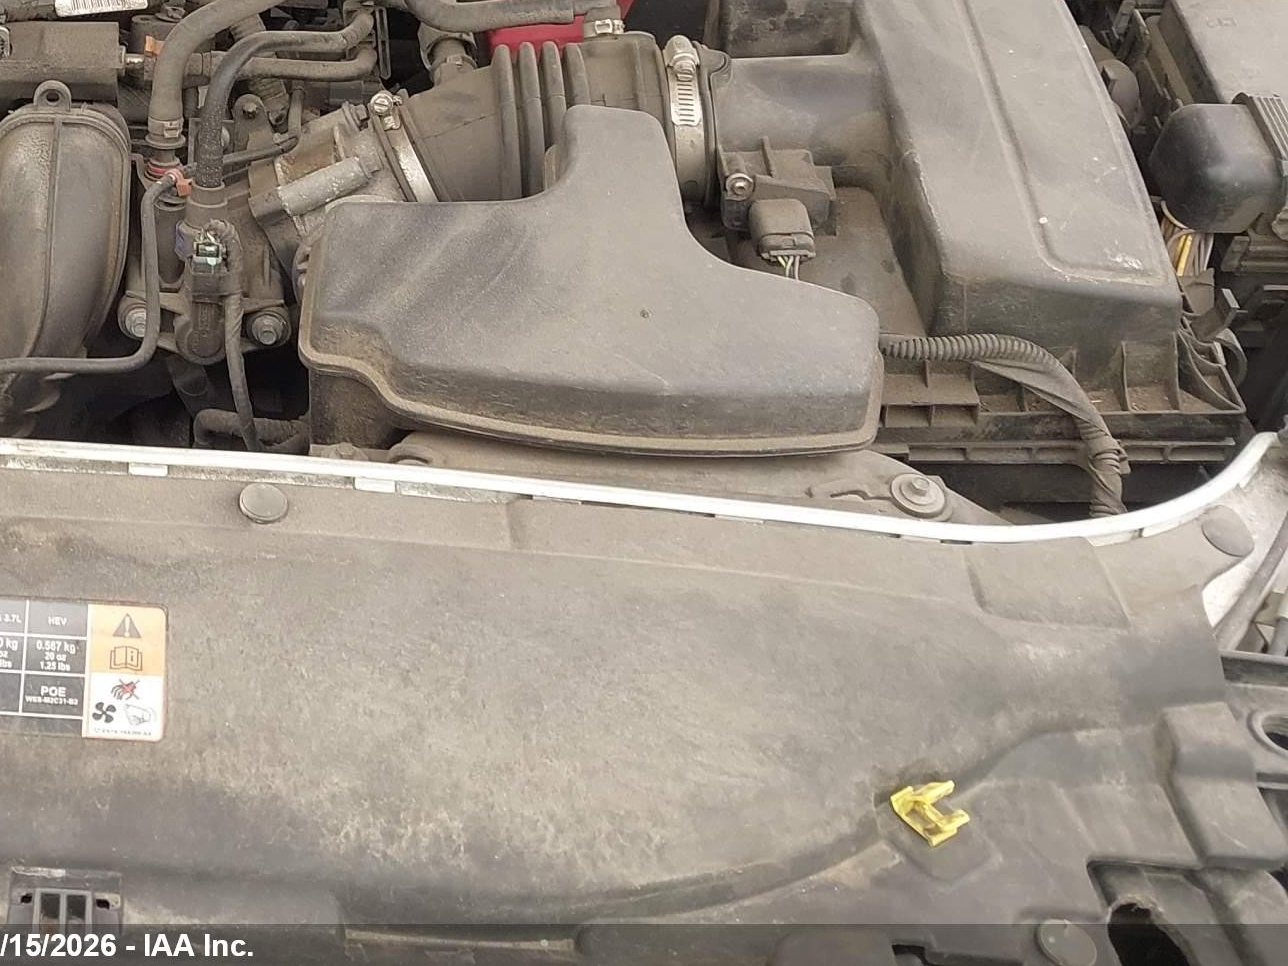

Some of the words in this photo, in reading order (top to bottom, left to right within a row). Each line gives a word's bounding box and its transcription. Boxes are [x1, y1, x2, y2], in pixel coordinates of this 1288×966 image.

[48, 615, 67, 626] HEV
[5, 638, 19, 651] kg
[64, 641, 76, 654] kg
[44, 652, 55, 661] 20
[56, 654, 67, 662] oz
[0, 659, 12, 669] lbs
[39, 661, 57, 671] 1.25
[58, 662, 71, 672] lbs
[40, 686, 67, 698] POE
